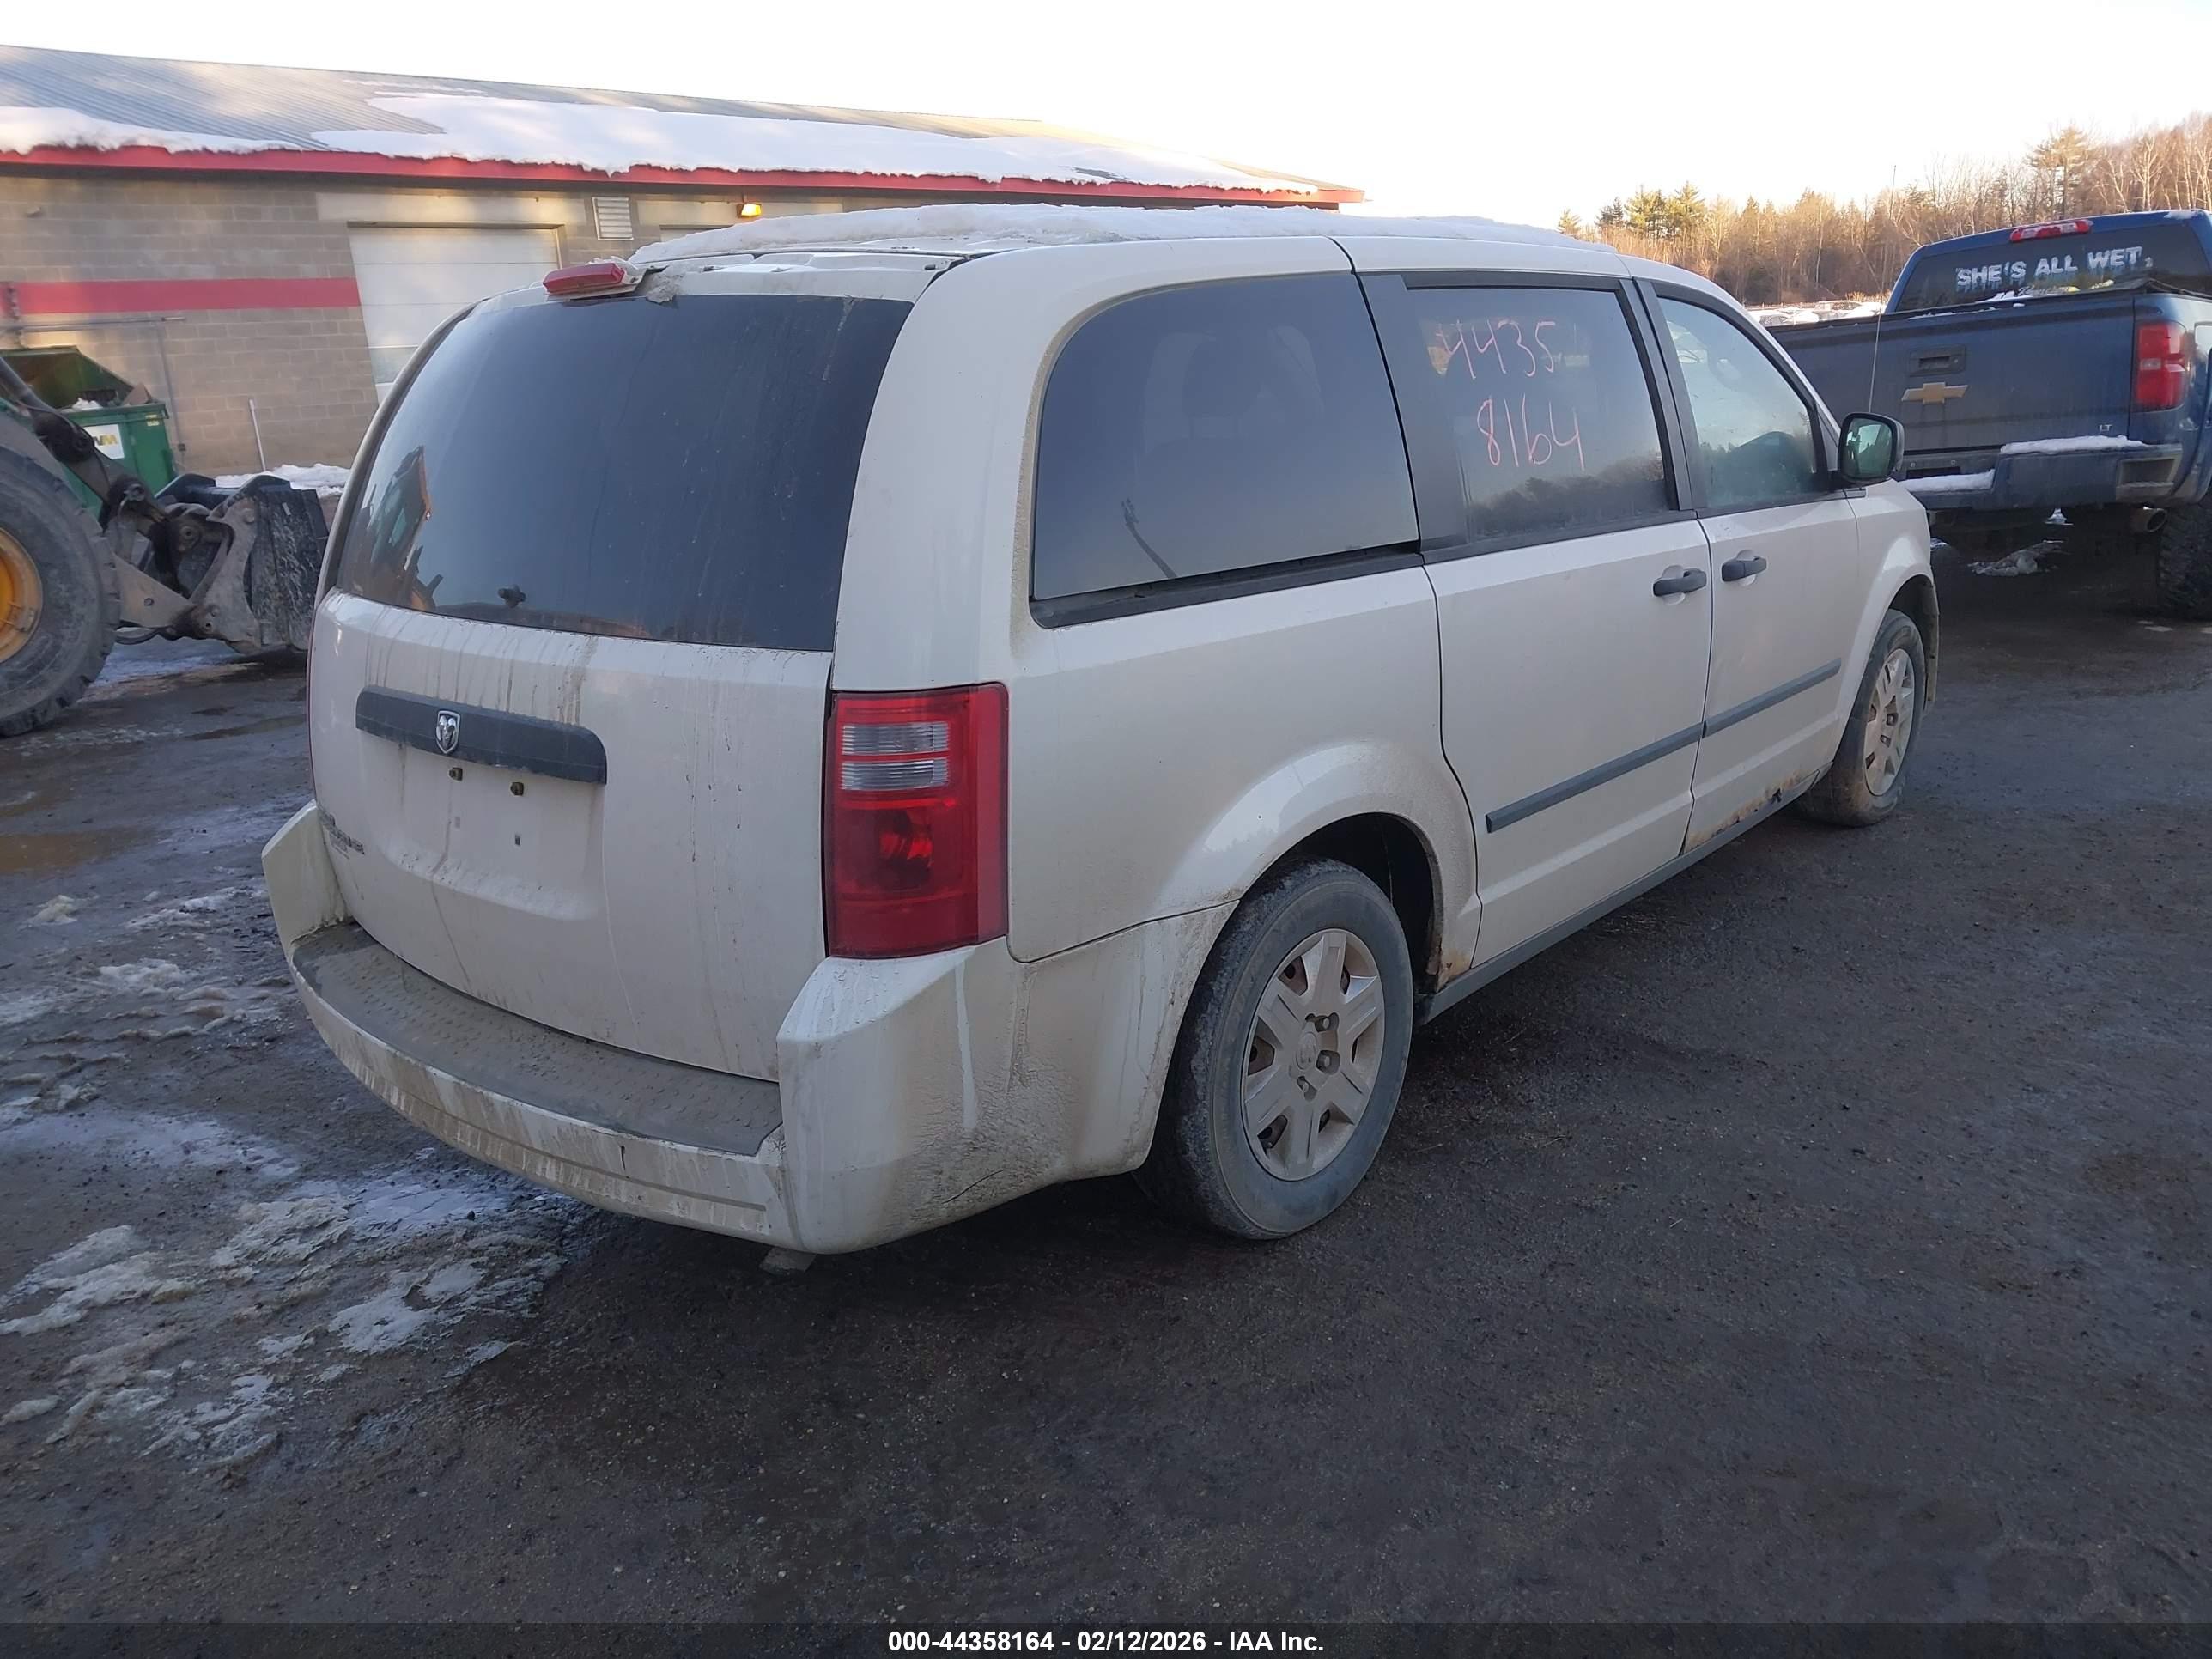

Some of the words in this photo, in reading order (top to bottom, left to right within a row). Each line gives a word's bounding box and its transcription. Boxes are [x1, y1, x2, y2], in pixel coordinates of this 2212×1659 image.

[2034, 254, 2079, 276] ALL
[2087, 246, 2143, 270] WET
[1436, 319, 1556, 380] 4435
[1477, 392, 1585, 471] 8164
